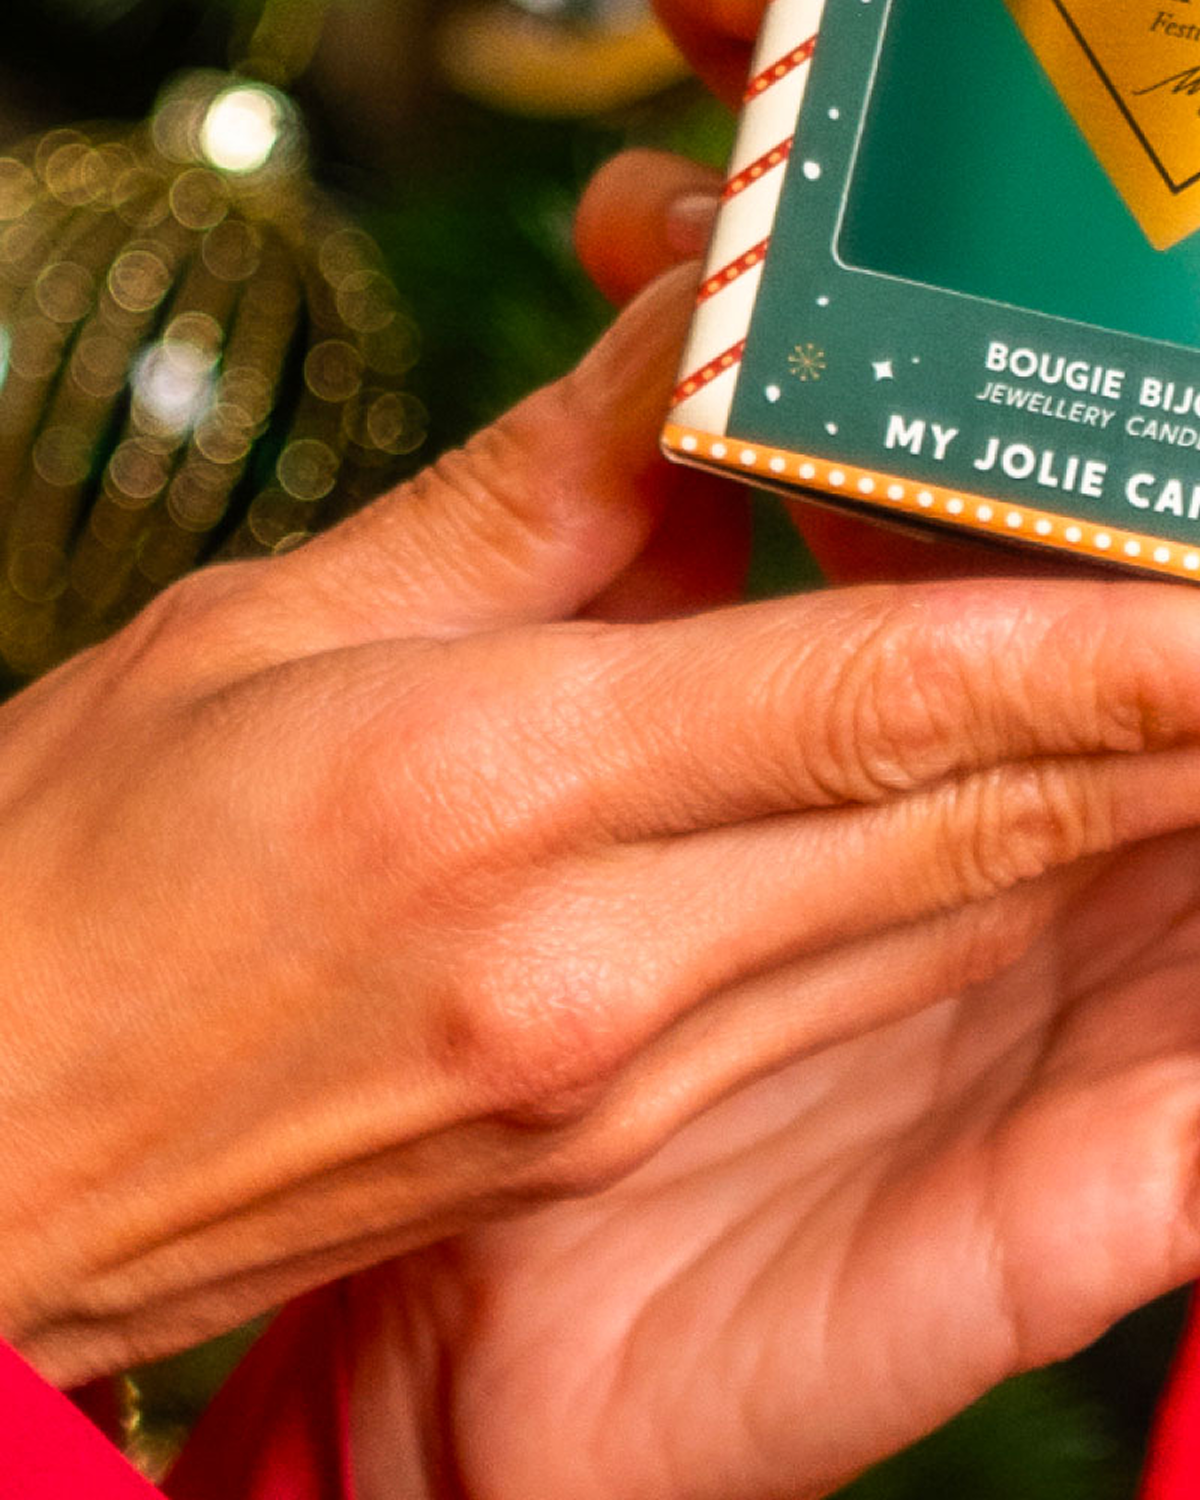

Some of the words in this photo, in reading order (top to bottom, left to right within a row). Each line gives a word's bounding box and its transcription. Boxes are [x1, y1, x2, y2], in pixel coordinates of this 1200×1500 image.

[985, 341, 1127, 400] BOUGIE
[976, 382, 1116, 430] JEWELLERY
[884, 414, 959, 461] MY
[973, 438, 1109, 499] JOLIE
